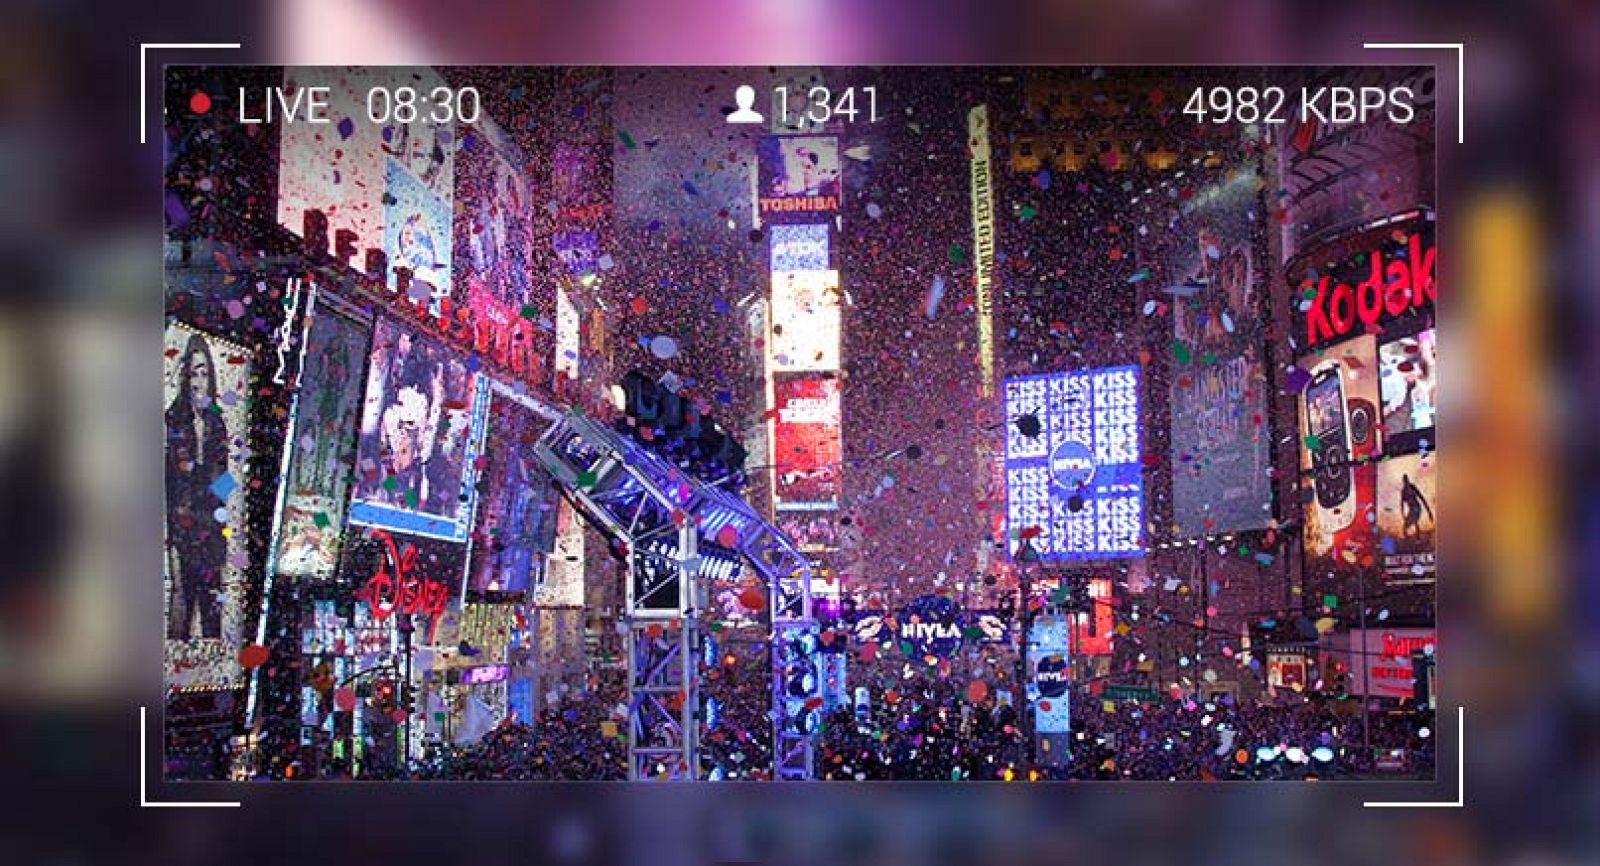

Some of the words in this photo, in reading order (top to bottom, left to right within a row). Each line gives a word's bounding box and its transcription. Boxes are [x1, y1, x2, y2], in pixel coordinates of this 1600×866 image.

[974, 160, 989, 221] EDITION
[760, 196, 838, 211] TOSHIBA
[1306, 233, 1436, 346] Kodak
[1093, 371, 1137, 391] KISS
[1094, 388, 1138, 409] KISS
[1094, 407, 1138, 427] KISS
[1008, 467, 1049, 486] KISS
[1008, 484, 1049, 504] KISS
[1097, 497, 1140, 516] KISS
[1097, 514, 1141, 533] KISS
[901, 622, 962, 641] NIVEA
